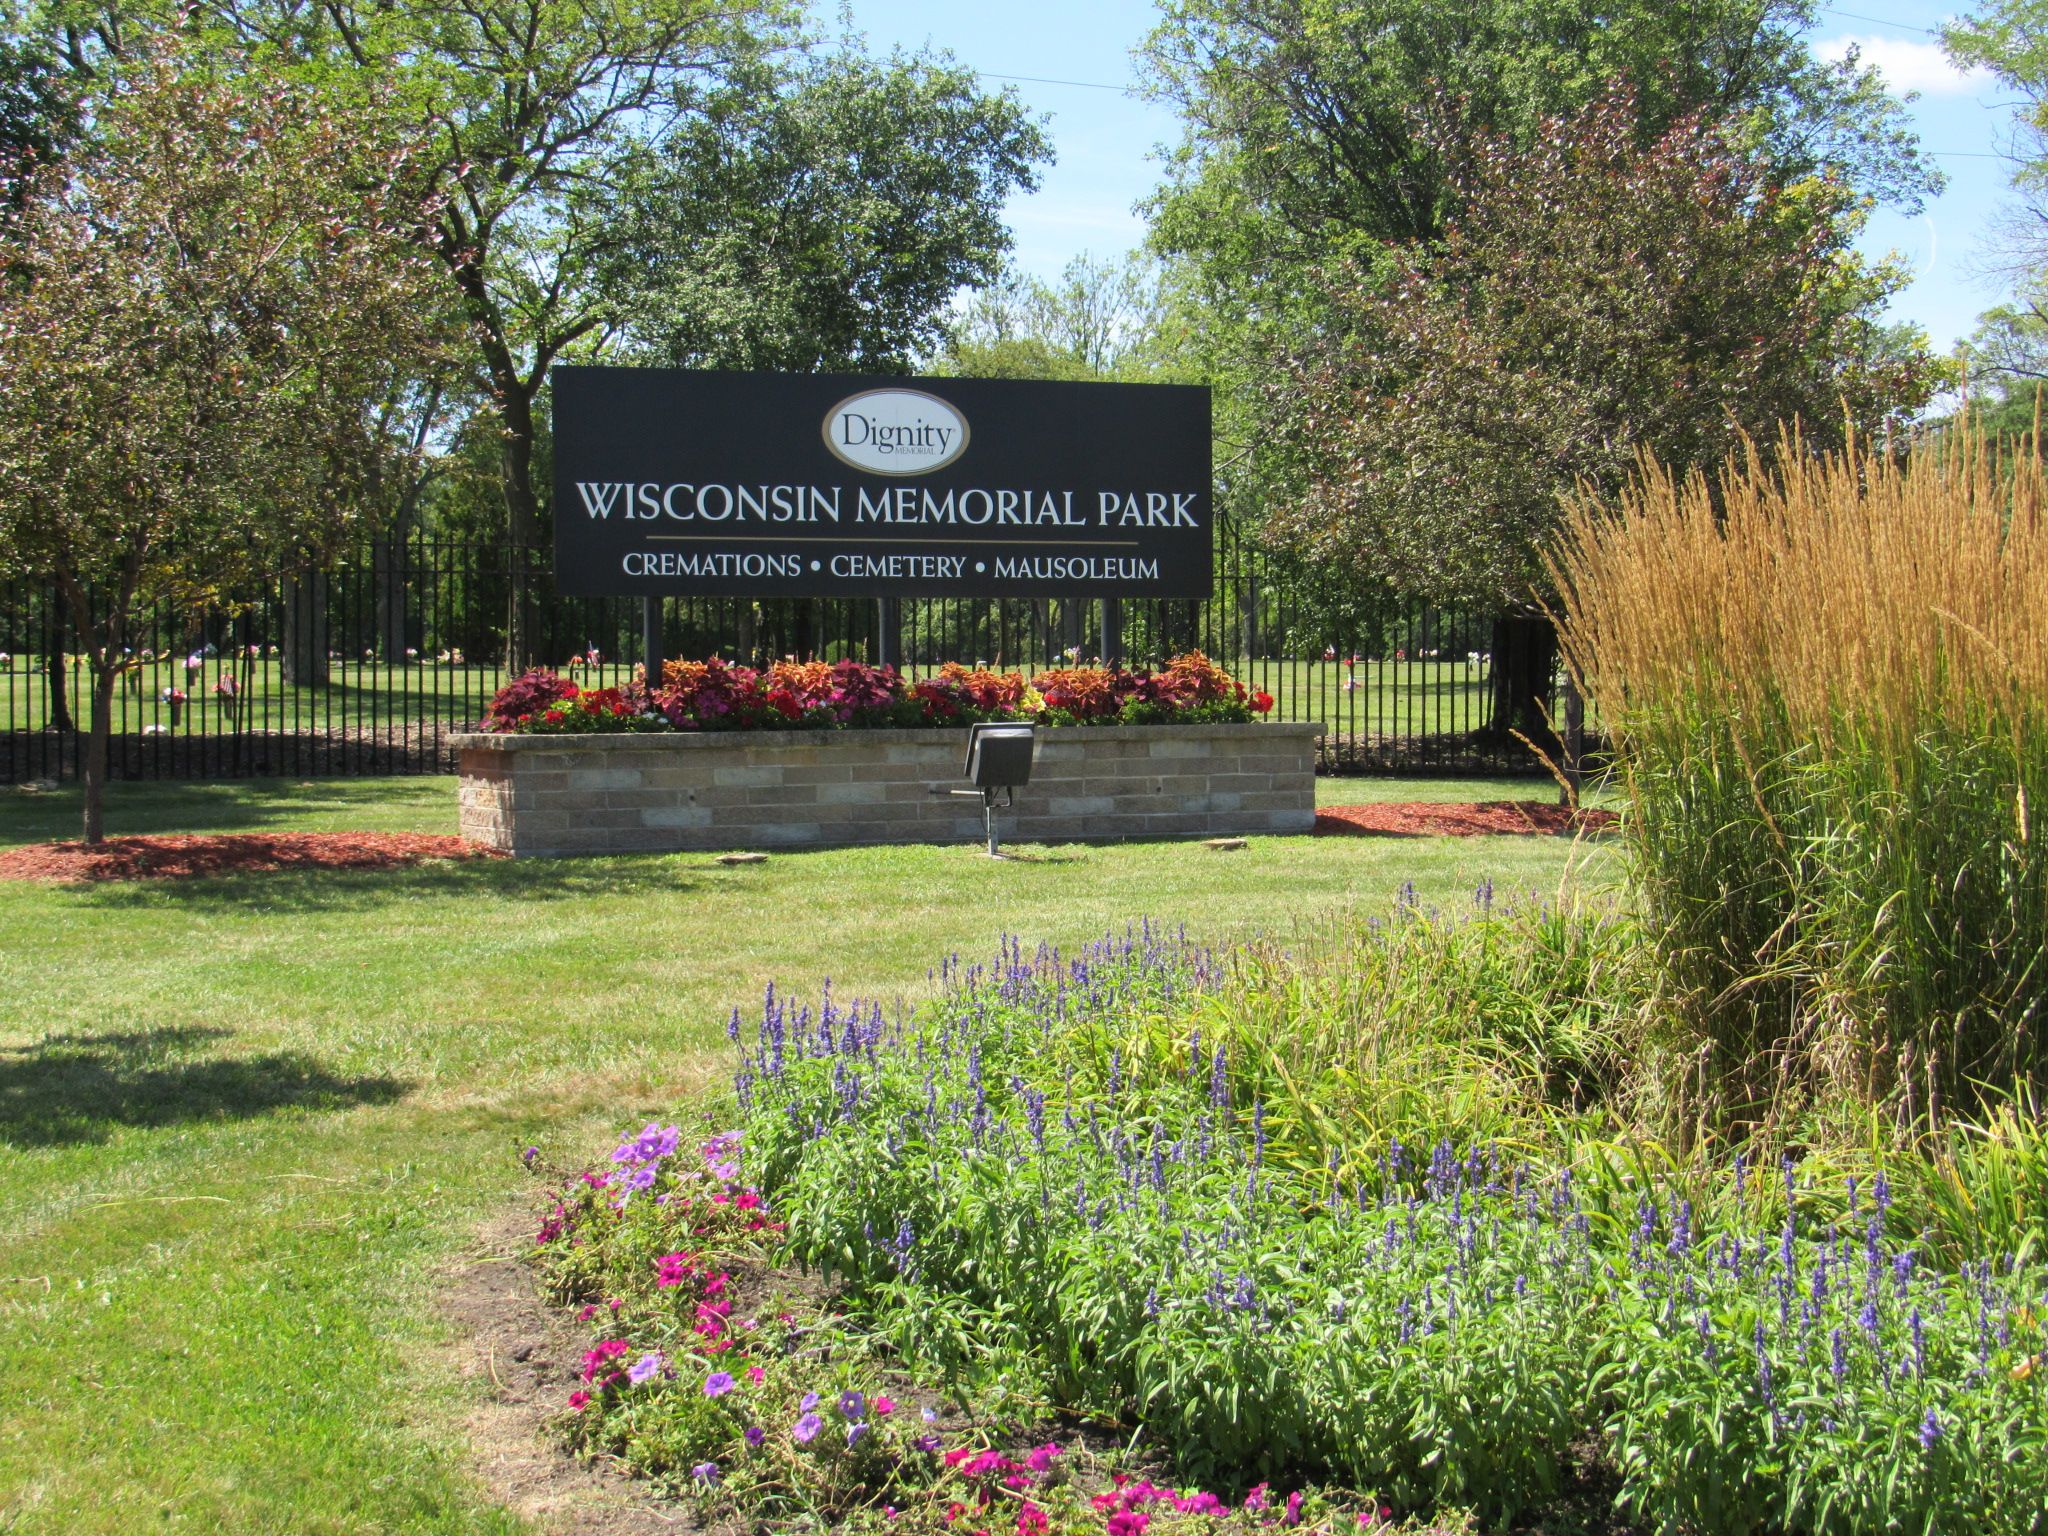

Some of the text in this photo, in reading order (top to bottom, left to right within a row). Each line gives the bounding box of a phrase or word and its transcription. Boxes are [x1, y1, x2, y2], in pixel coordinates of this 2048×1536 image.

[842, 413, 952, 455] Dignity
[895, 446, 935, 456] MEMORIAL
[575, 482, 1199, 528] WISCONSIN MEMORIAL PARK
[622, 552, 1160, 580] CREMATIONS CEMETERY MAUSOLEUM
